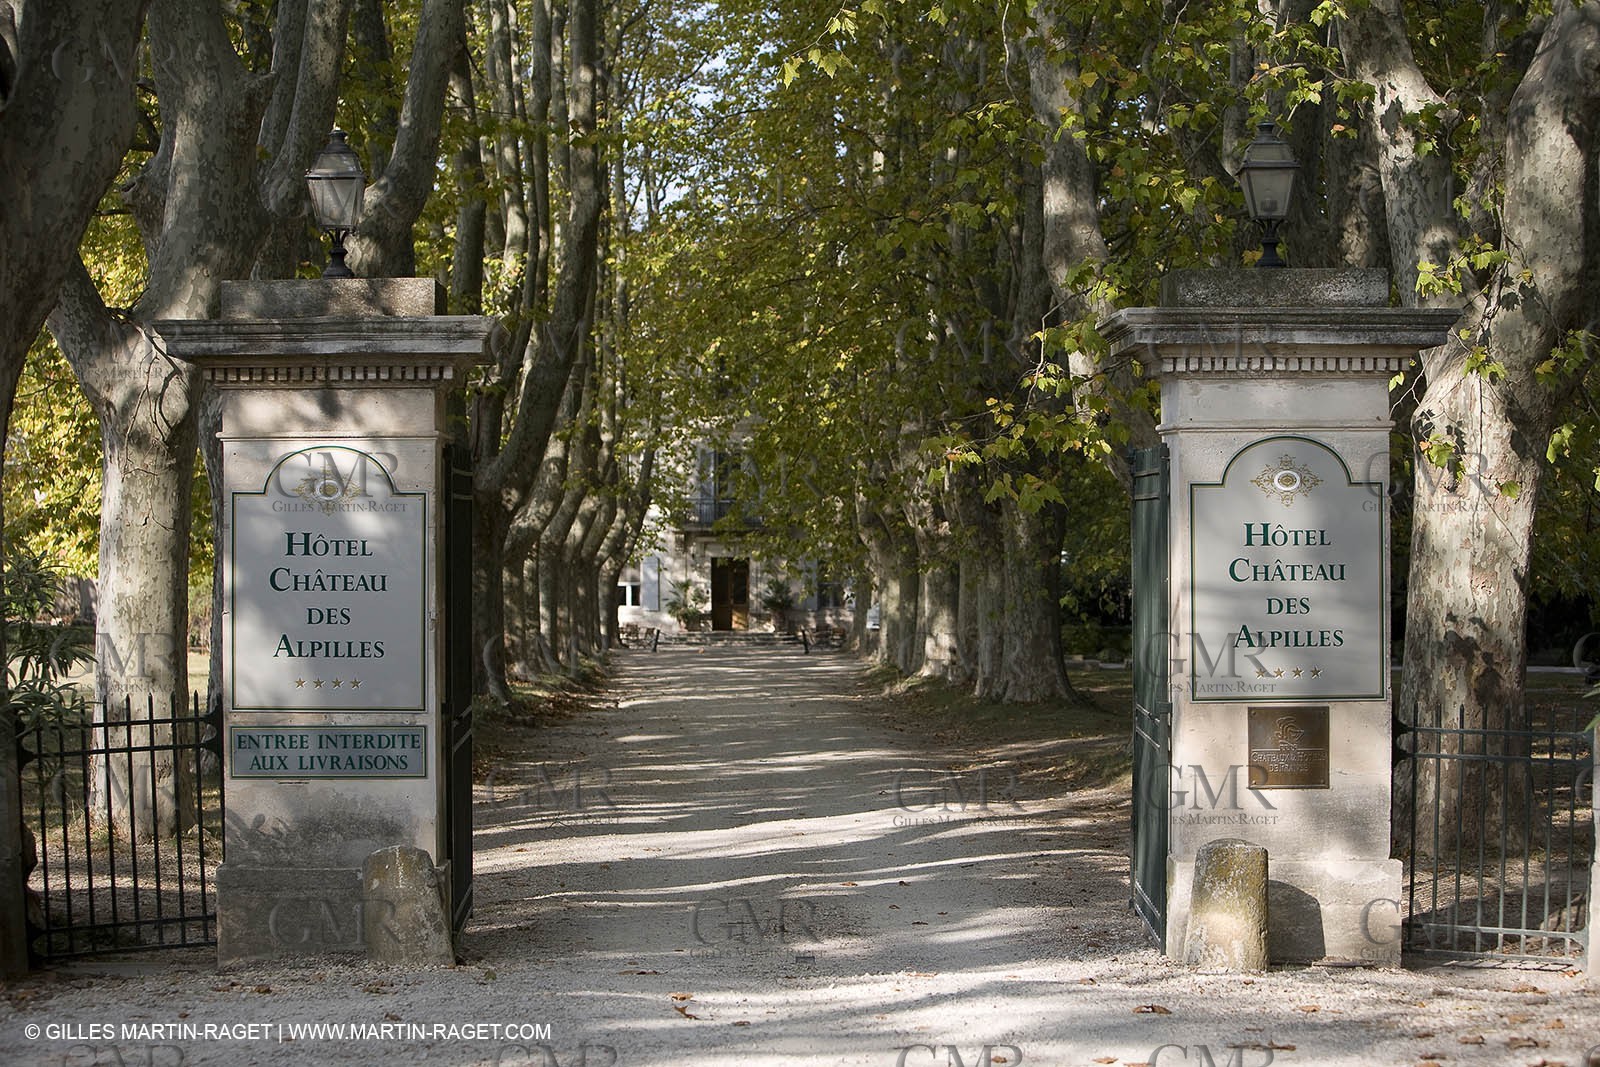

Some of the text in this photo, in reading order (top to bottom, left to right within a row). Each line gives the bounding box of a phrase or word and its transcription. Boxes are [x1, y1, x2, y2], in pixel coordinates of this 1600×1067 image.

[1266, 597, 1311, 615] DES
[306, 607, 351, 625] DES
[1233, 624, 1344, 648] ALPILLES
[272, 633, 385, 658] ALPILLES
[237, 734, 421, 750] ENTREE INTERDITE
[250, 755, 408, 771] AUX LIVRAISONS
